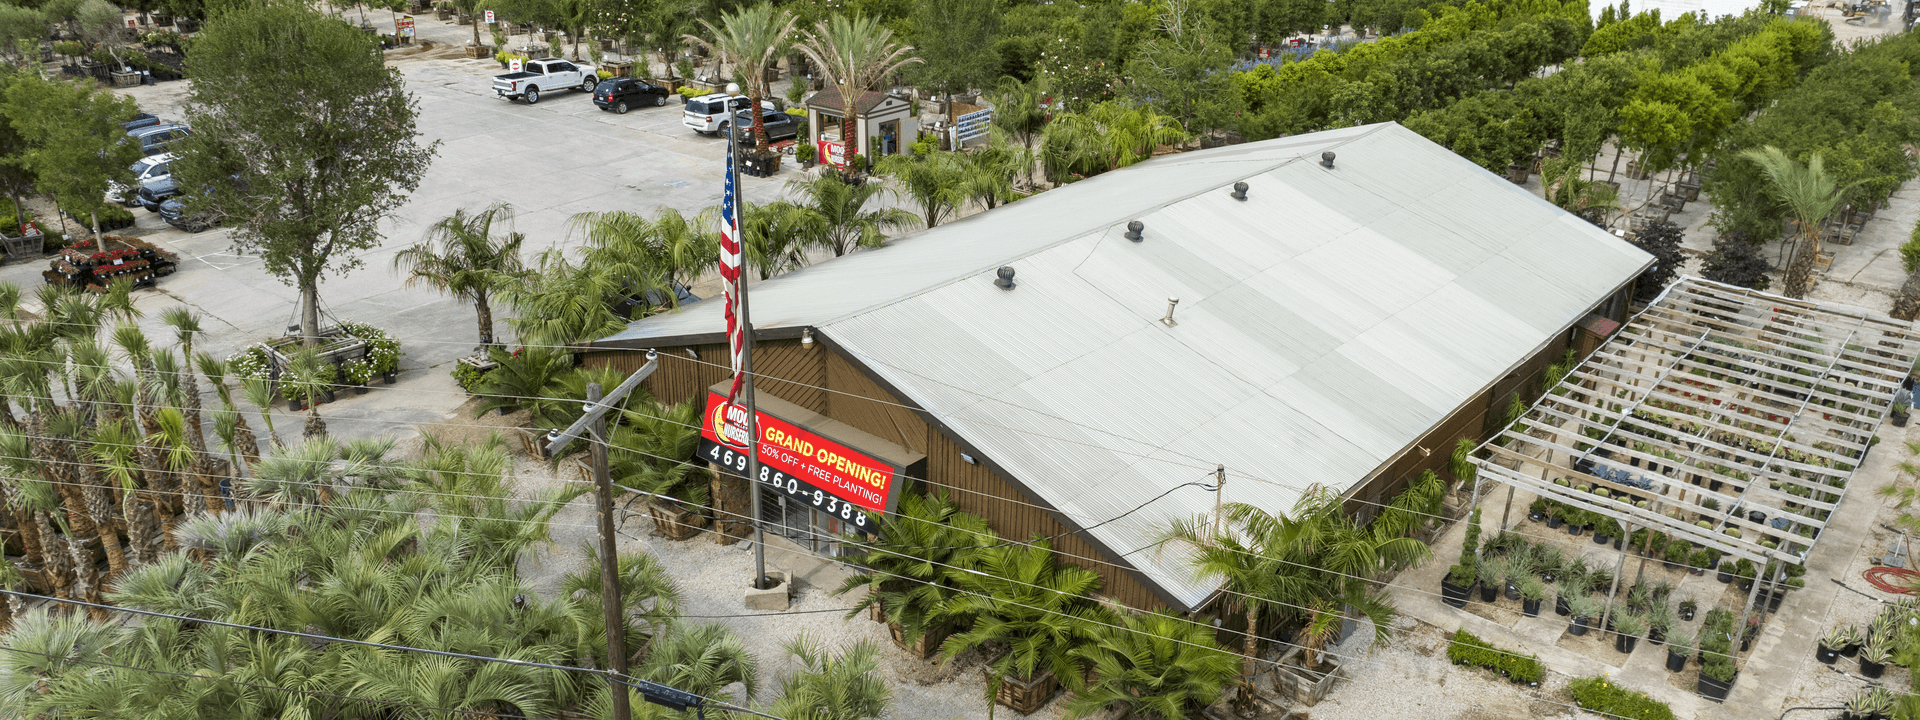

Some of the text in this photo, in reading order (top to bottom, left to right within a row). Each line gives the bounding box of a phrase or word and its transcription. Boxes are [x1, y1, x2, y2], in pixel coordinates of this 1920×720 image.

[761, 444, 779, 460] 50%
[781, 452, 799, 467] OFF
[807, 464, 831, 483] FREE
[832, 475, 883, 505] PLANTING!
[765, 426, 887, 490] GRAND OPENING!
